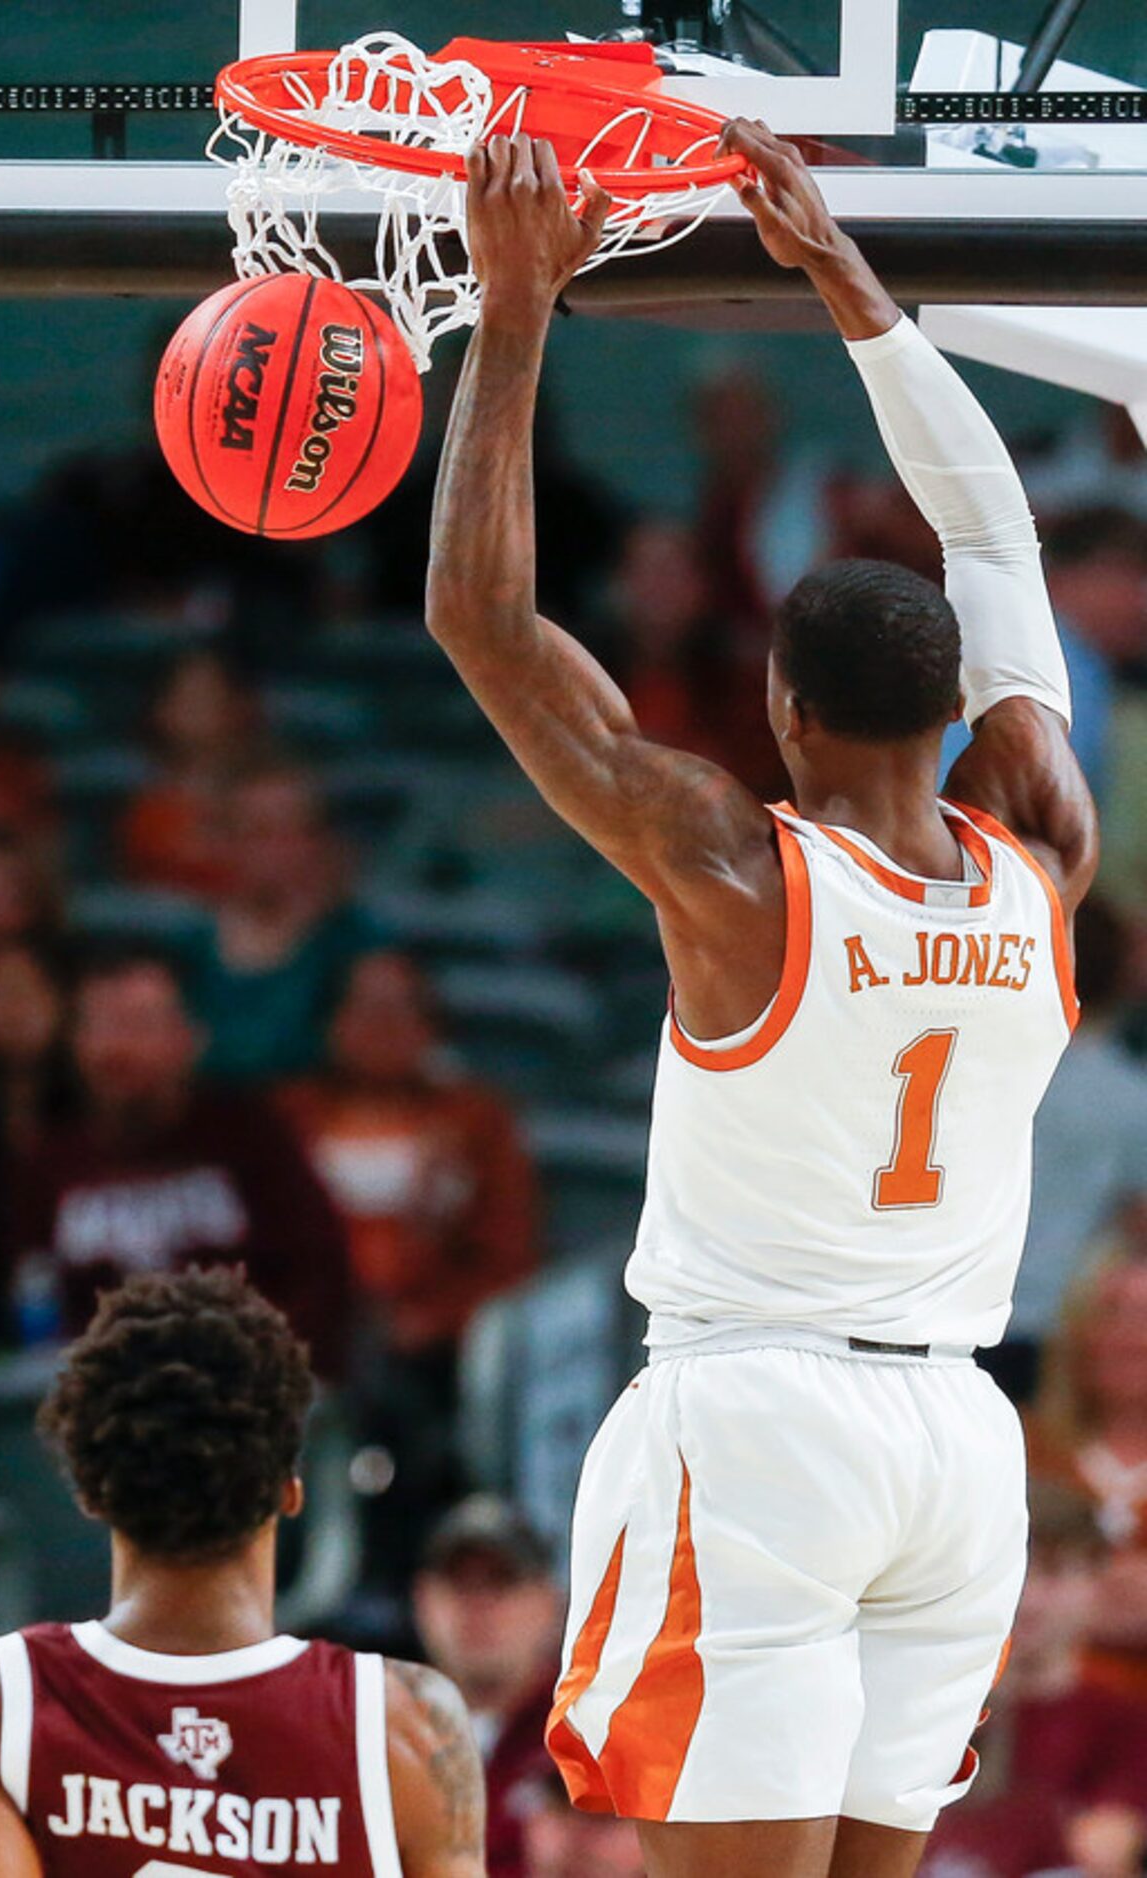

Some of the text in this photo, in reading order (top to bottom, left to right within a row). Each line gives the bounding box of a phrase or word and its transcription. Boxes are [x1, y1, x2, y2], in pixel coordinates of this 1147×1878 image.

[219, 320, 277, 452] NCAA
[284, 322, 364, 493] Wilson
[844, 931, 1036, 993] A. JONES
[871, 1025, 959, 1211] 1
[47, 1773, 341, 1865] JACKSON
